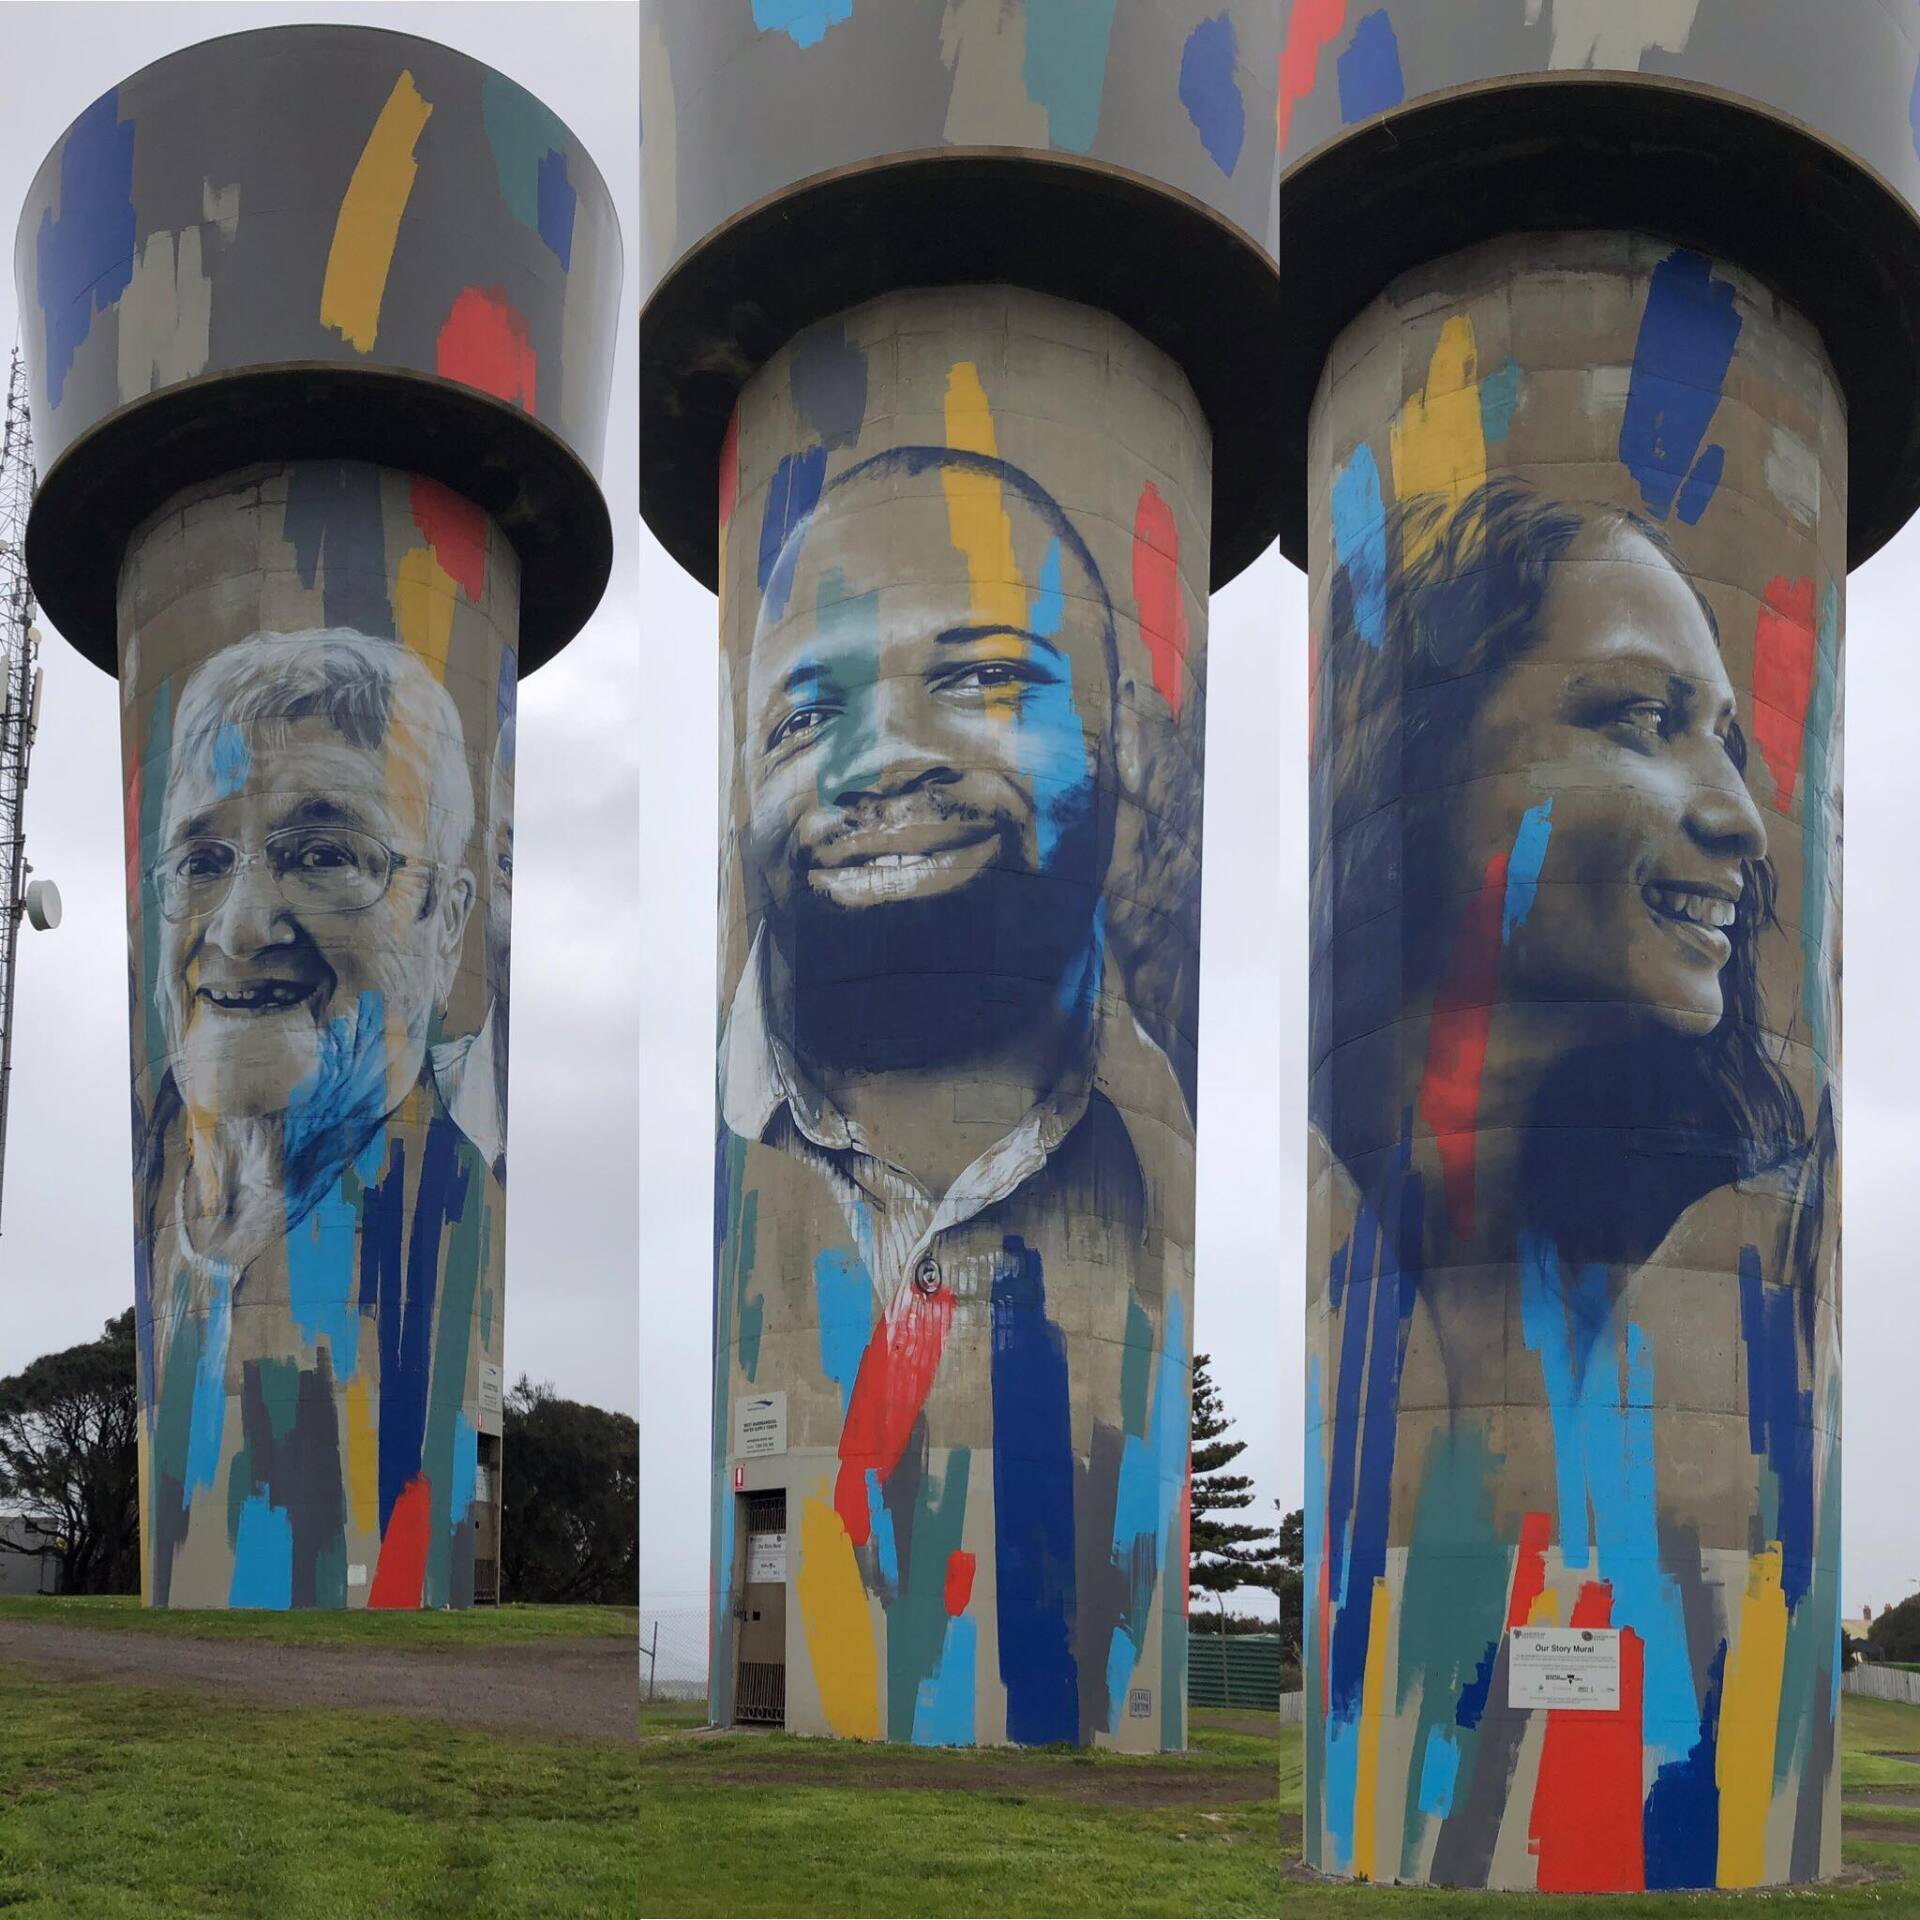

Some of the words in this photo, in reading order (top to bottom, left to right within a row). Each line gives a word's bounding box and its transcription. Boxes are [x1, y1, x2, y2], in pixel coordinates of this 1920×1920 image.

[1535, 1644, 1549, 1652] Our
[1551, 1644, 1571, 1654] Story
[1573, 1645, 1594, 1653] Mural
